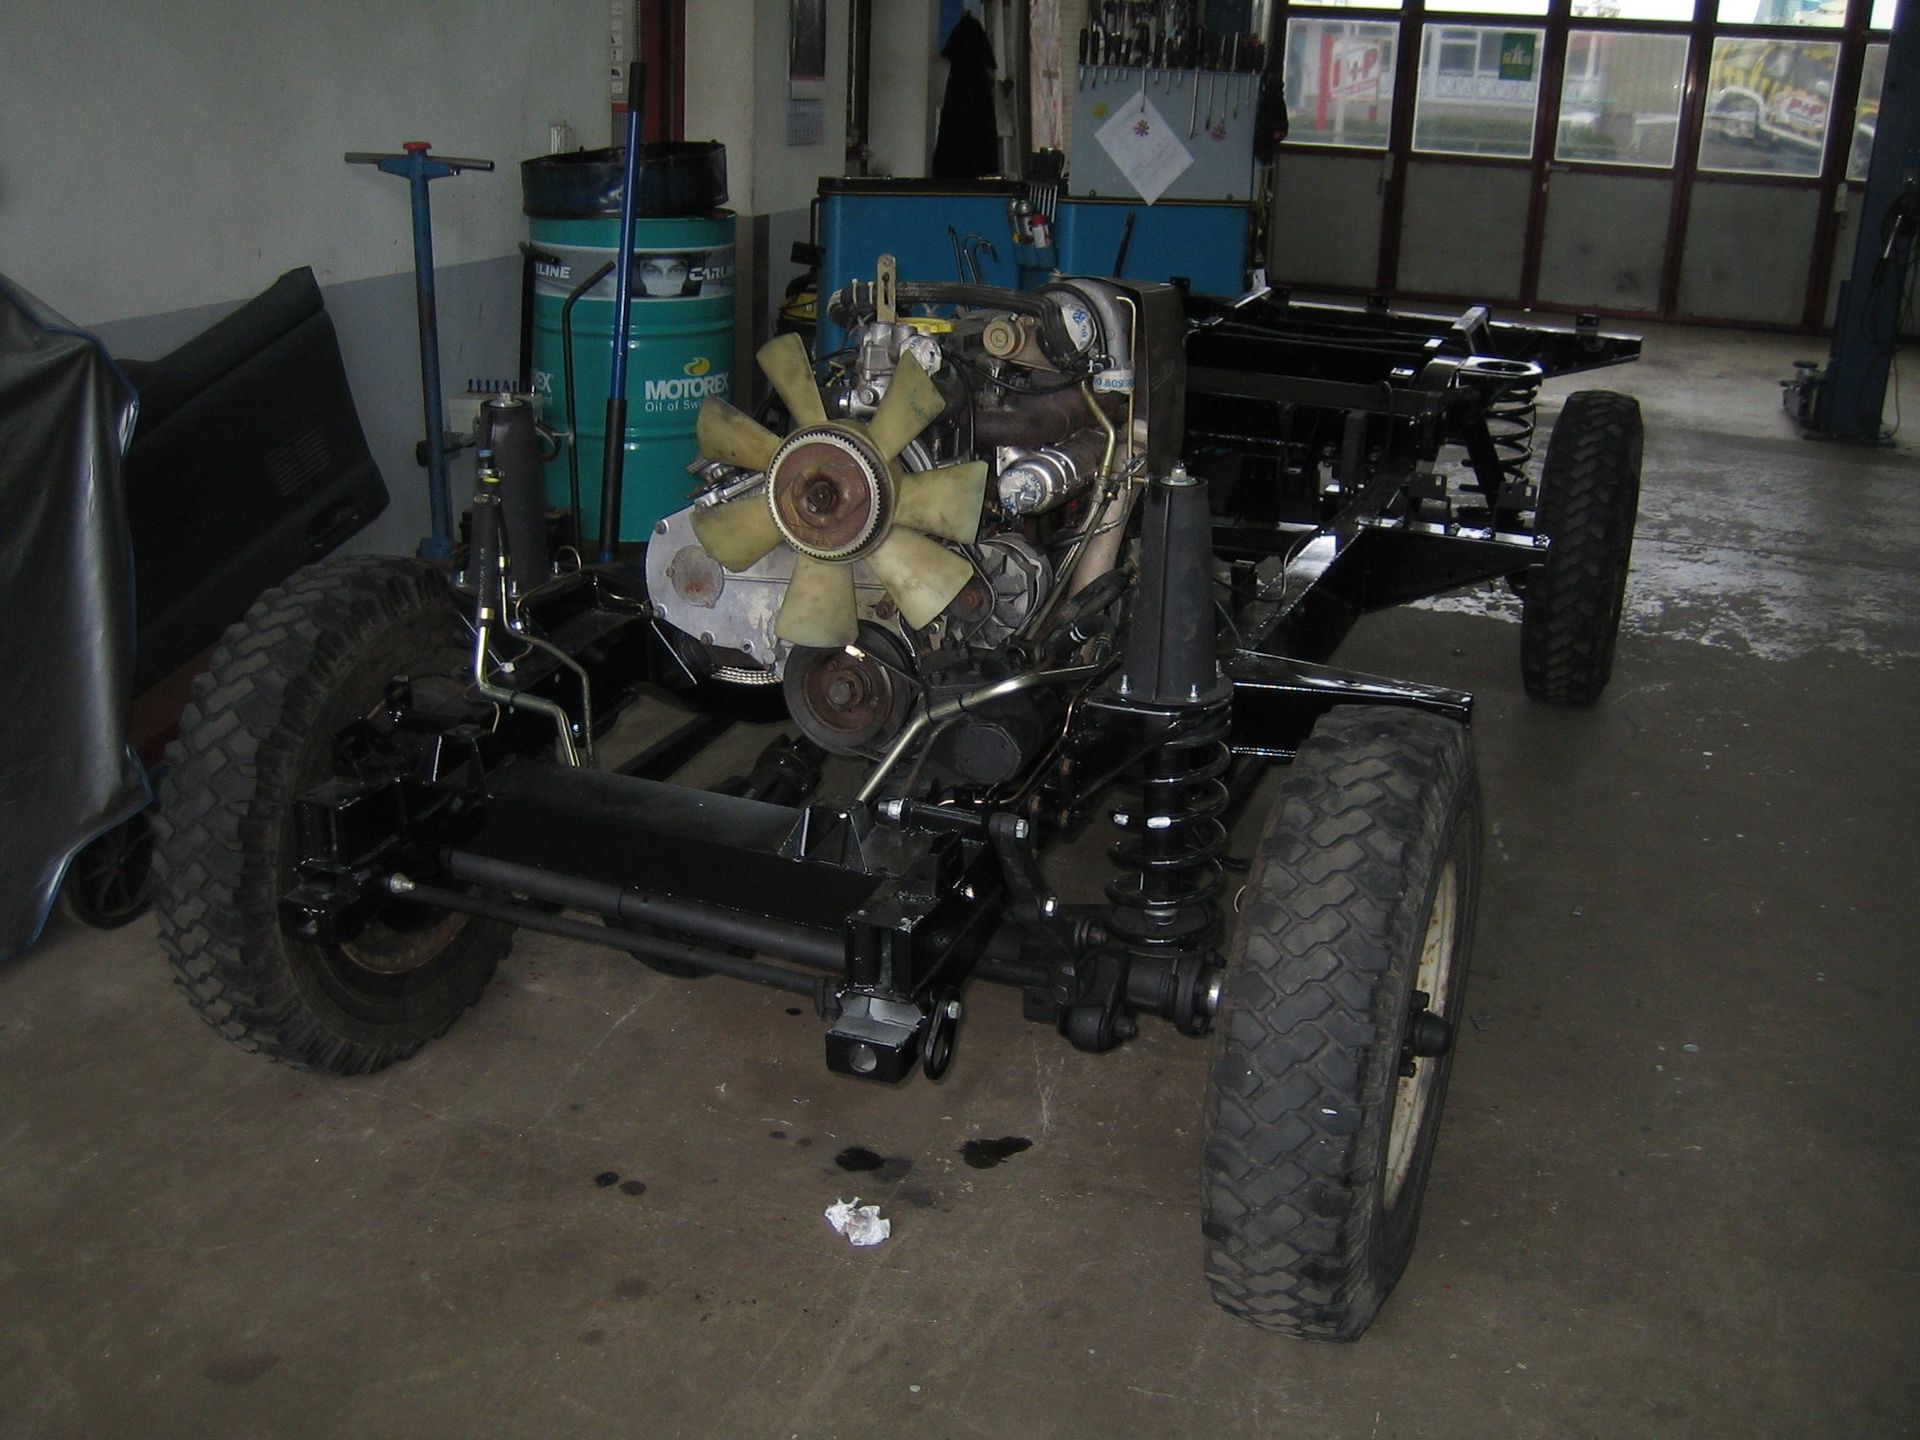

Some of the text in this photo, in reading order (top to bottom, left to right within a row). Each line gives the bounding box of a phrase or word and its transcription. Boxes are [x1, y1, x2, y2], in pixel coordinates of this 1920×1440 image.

[645, 373, 729, 400] MOTOREX
[645, 401, 662, 412] Oil
[667, 400, 679, 411] of
